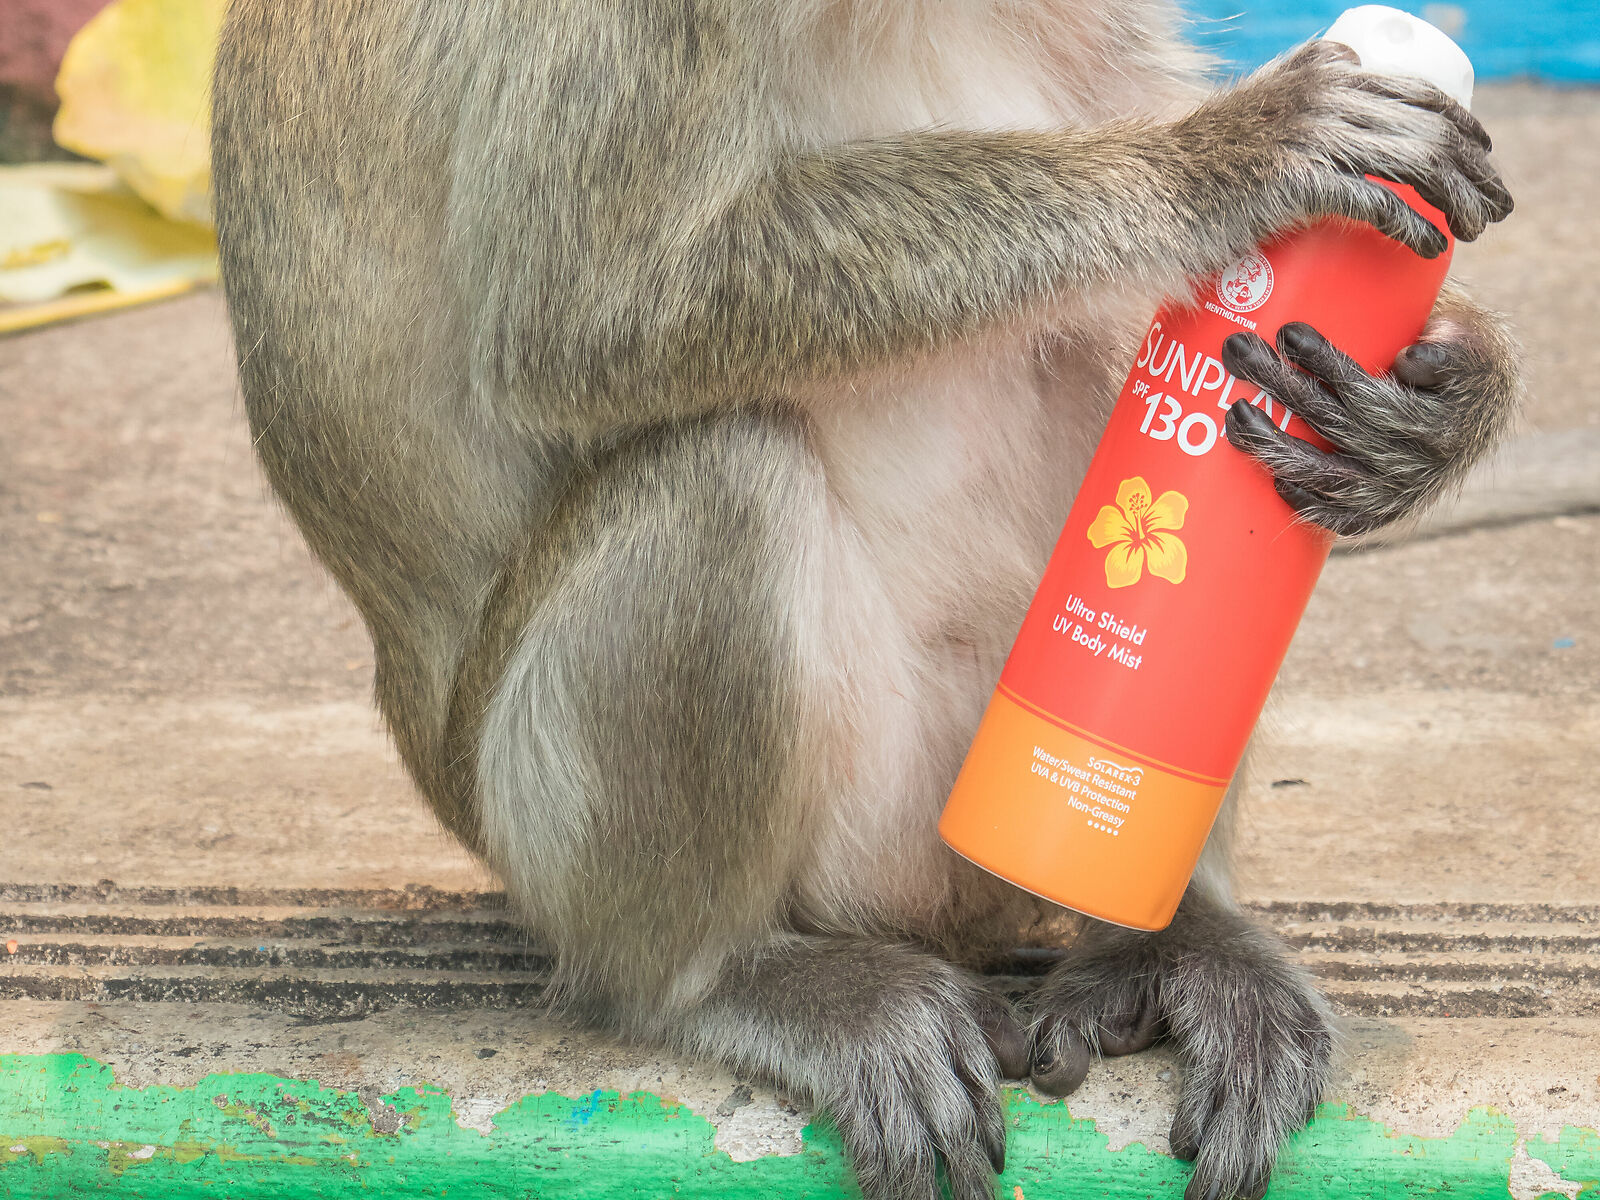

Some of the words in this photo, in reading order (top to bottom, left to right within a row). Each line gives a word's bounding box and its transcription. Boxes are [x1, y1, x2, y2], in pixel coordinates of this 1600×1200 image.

[1204, 301, 1257, 330] MENTHOLATUM
[1132, 380, 1151, 399] SPF
[1139, 392, 1217, 456] 130
[1052, 613, 1073, 635] UV
[1071, 624, 1107, 657] Body
[1107, 643, 1142, 670] Mist
[1065, 594, 1096, 623] Ultra
[1097, 611, 1147, 646] Shield
[1031, 761, 1050, 779] UVA
[1050, 772, 1058, 784] &
[1059, 775, 1081, 793] UVB
[1080, 785, 1130, 814] Protection
[1032, 745, 1091, 782] Water/Sweat
[1091, 773, 1136, 800] Resistant
[1067, 795, 1125, 828] Non-Greasy
